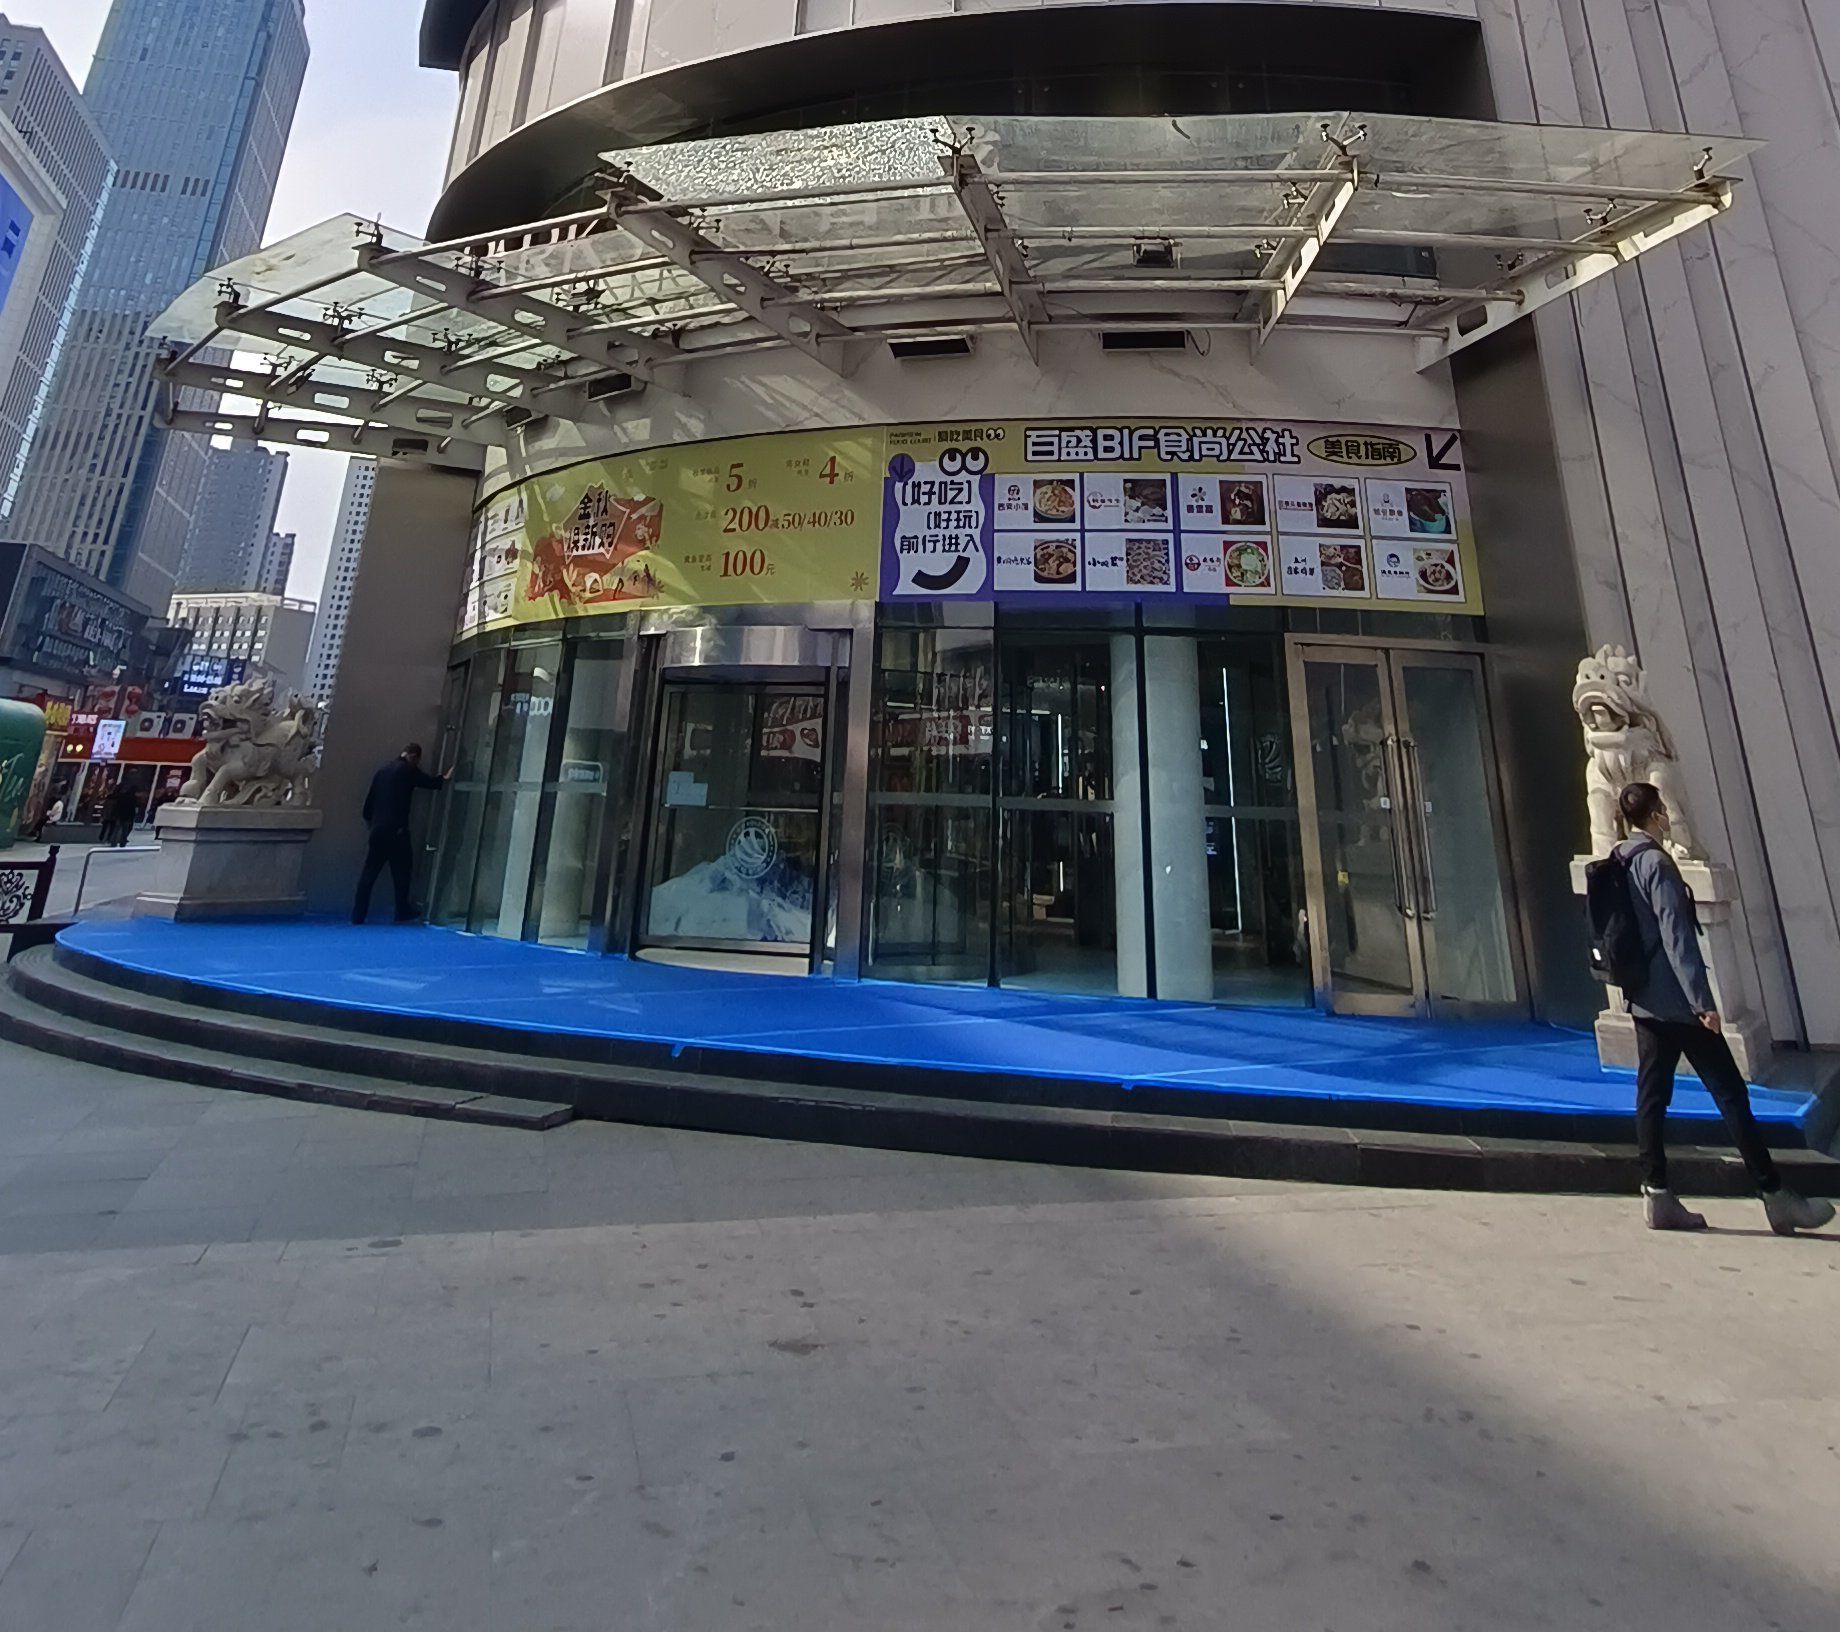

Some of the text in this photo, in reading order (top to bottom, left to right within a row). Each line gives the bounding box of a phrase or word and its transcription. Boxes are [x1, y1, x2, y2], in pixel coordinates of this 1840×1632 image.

[1025, 427, 1301, 463] 百盛BIF食尚公社
[1324, 438, 1402, 462] 美食指南
[726, 462, 744, 493] 5
[819, 455, 839, 485] 4
[899, 533, 980, 554] 前行进入
